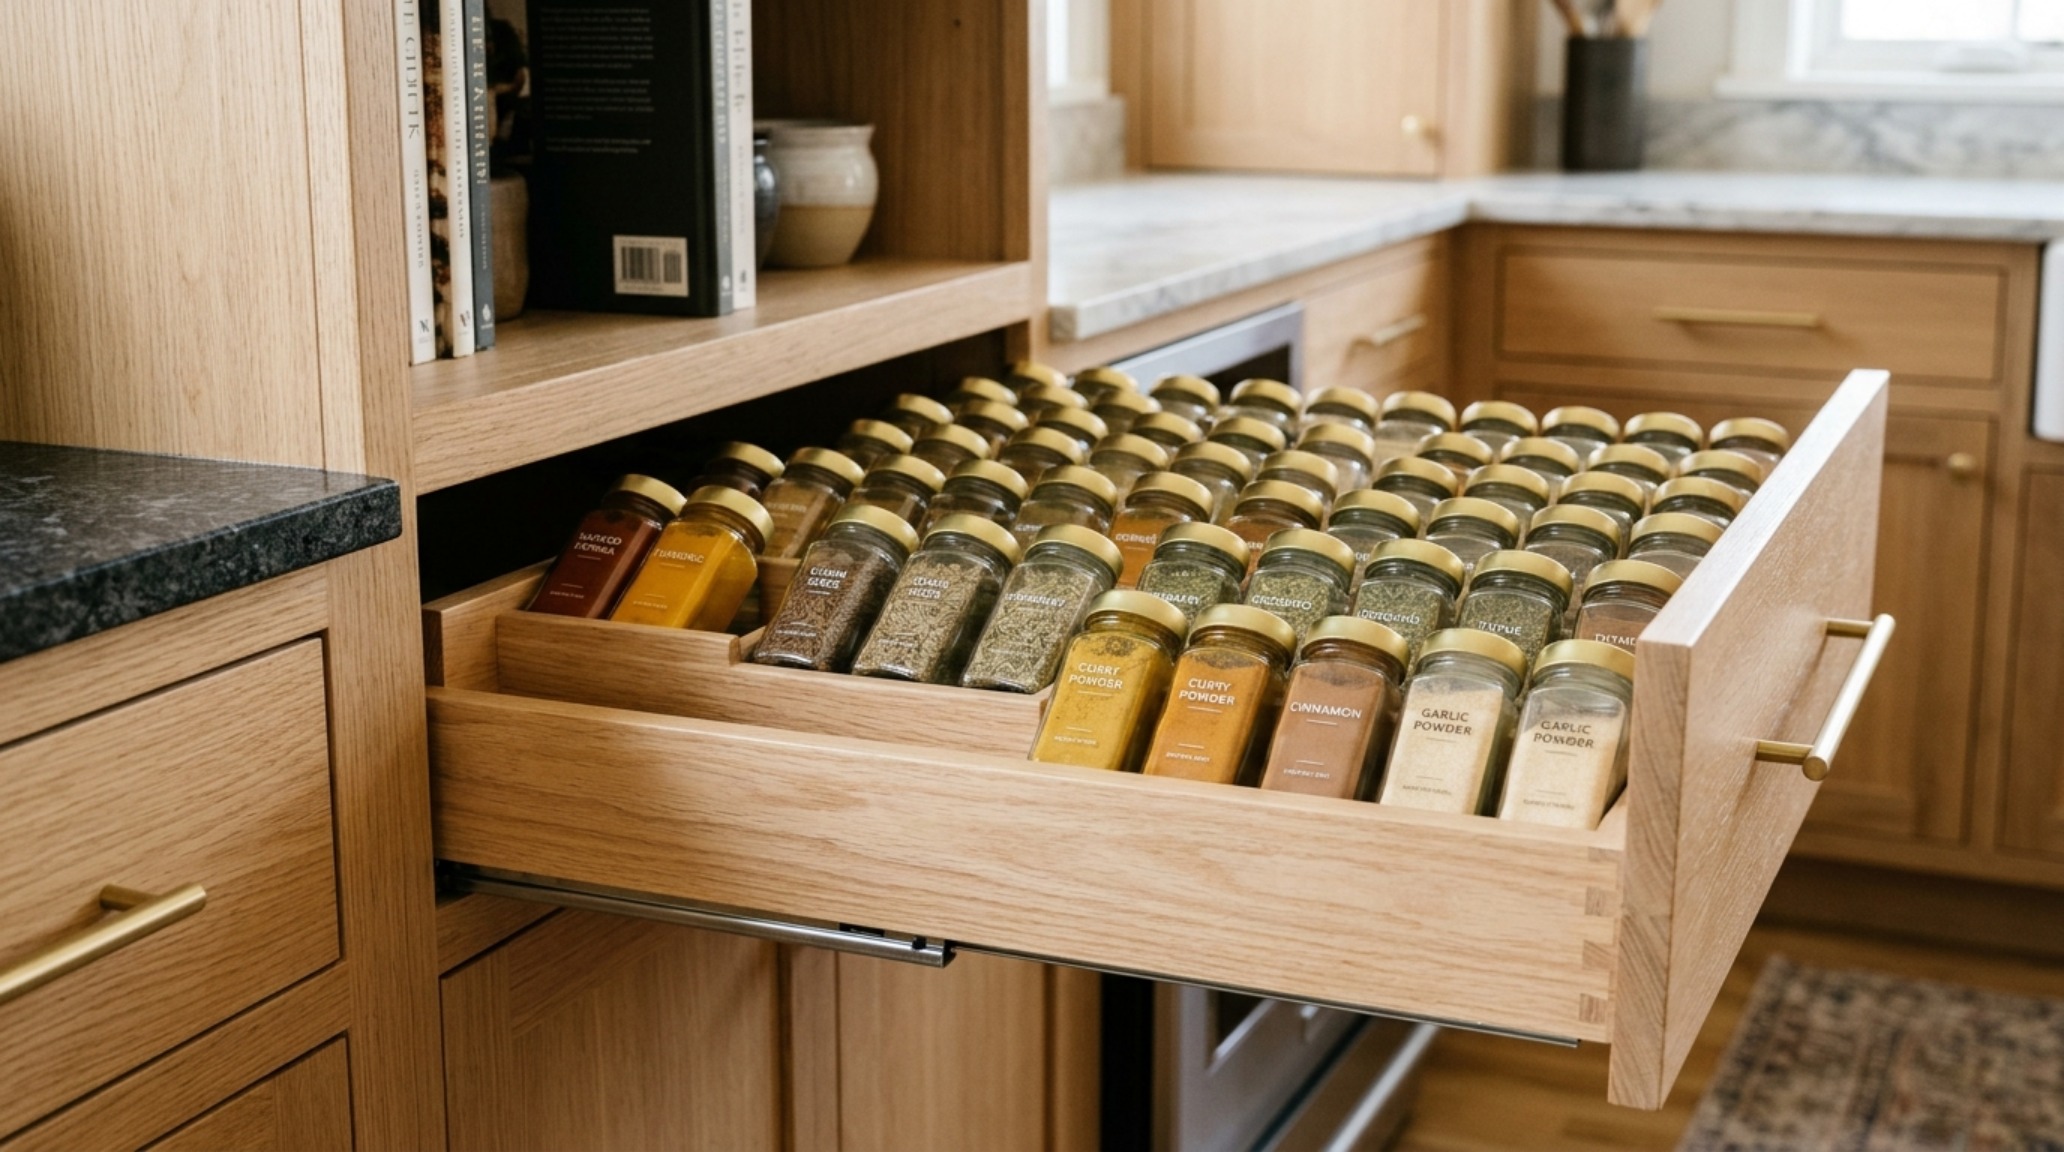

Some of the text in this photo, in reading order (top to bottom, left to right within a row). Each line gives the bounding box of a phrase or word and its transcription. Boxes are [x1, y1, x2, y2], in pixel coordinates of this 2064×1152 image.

[1178, 689, 1236, 706] POWDER
[1289, 701, 1363, 719] CINNAMON
[1421, 707, 1470, 722] GARLIC
[1413, 720, 1473, 736] POWDER
[1540, 720, 1593, 735] GARLIC
